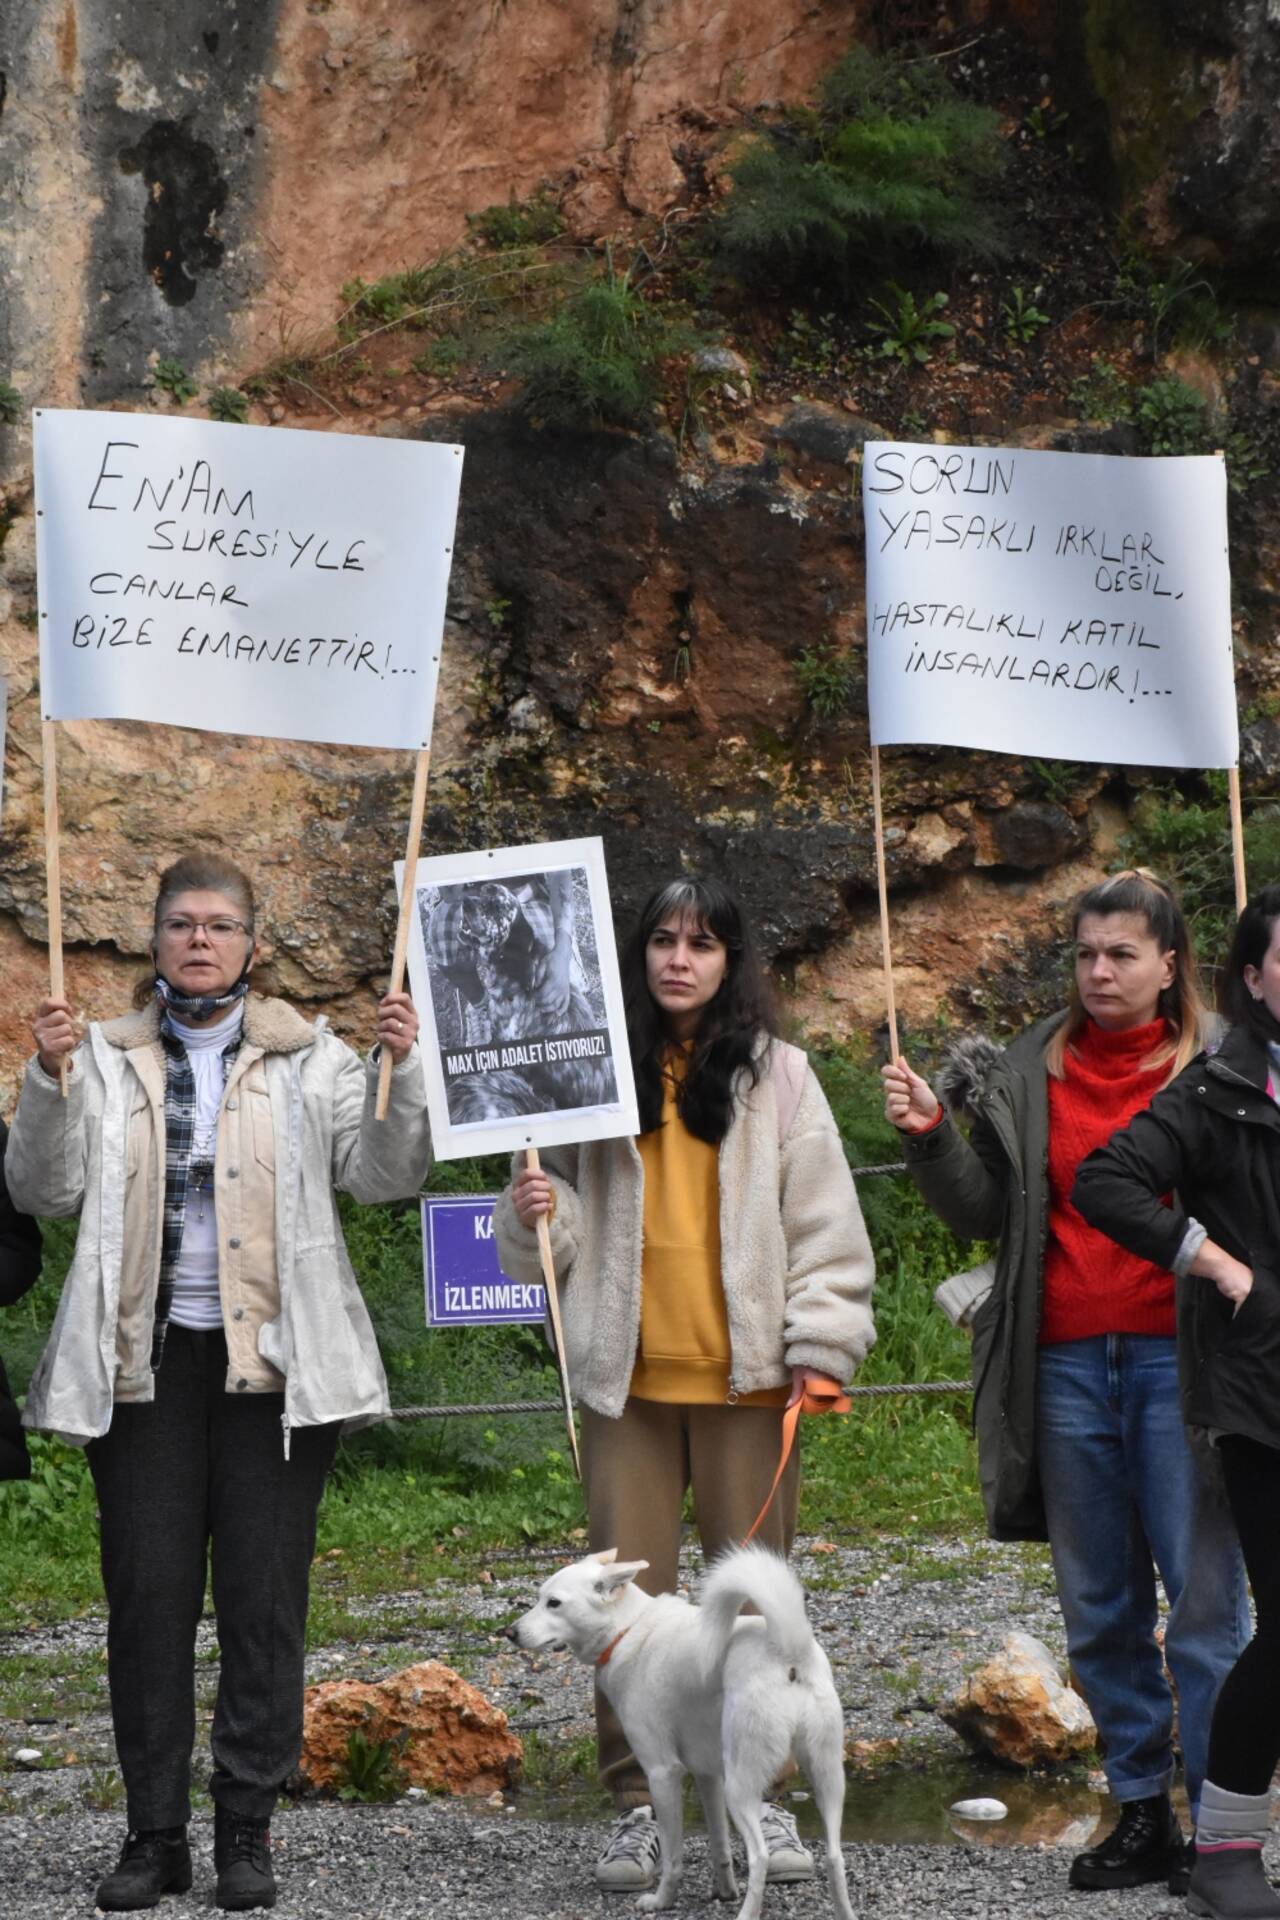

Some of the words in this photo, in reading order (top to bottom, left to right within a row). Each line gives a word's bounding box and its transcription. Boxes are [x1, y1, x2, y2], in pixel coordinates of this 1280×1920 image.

[868, 452, 1015, 496] SORUN
[878, 508, 1036, 553] YASAKLI
[1055, 525, 1165, 565] IRKLAR
[89, 573, 249, 608] CANLAR
[872, 601, 1045, 640] HASTALIKLI
[446, 1053, 474, 1075] MAX
[502, 1043, 543, 1067] ADALET
[444, 1282, 547, 1311] İZLENMEKT
